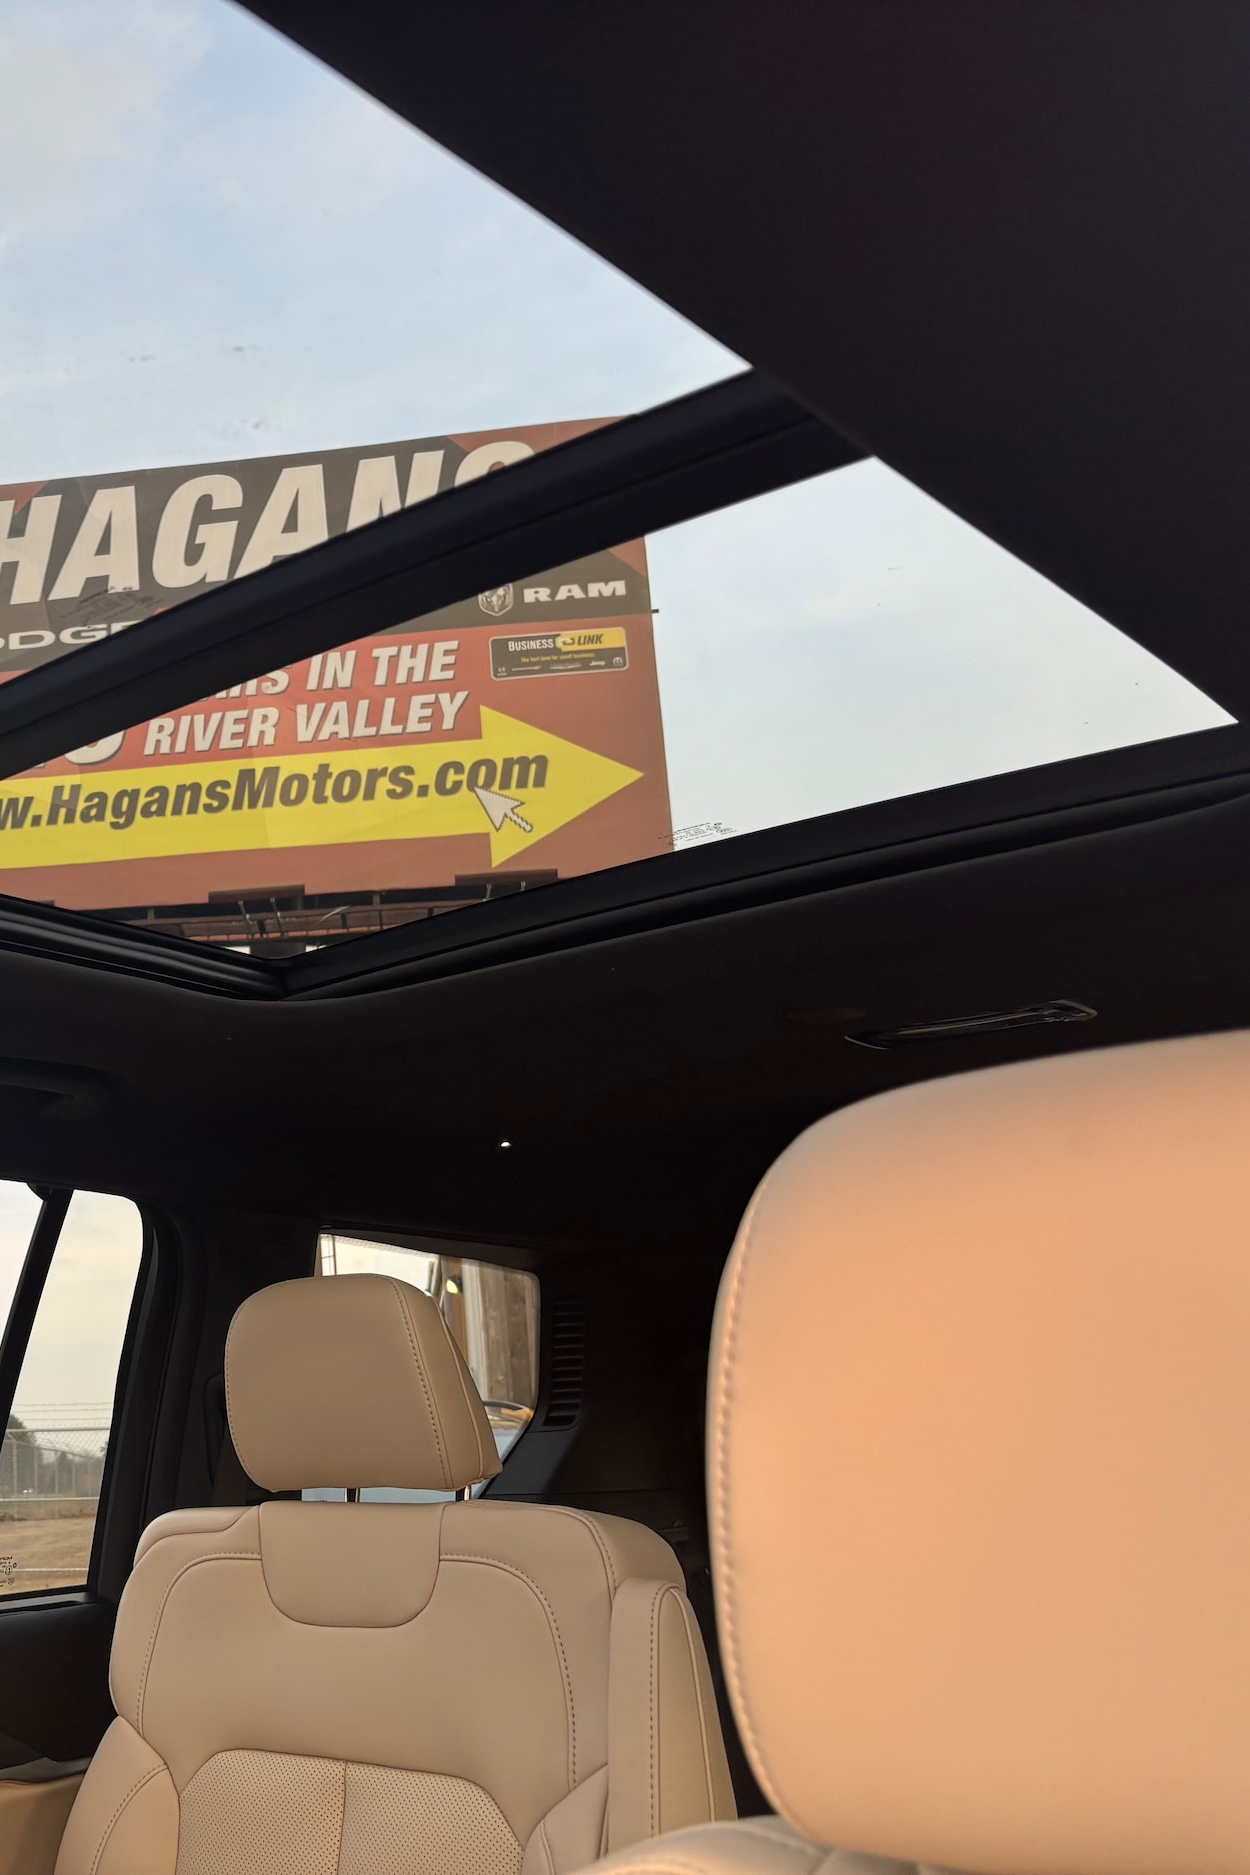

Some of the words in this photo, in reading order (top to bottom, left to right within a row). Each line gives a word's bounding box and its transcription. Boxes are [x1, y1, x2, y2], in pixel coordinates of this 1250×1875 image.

[523, 580, 626, 603] RAM
[508, 638, 554, 652] BUSINESS
[577, 633, 604, 646] LINK
[306, 649, 356, 692] IN
[371, 640, 459, 687] THE
[143, 706, 280, 756] RIVER
[296, 690, 469, 744] VALLEY
